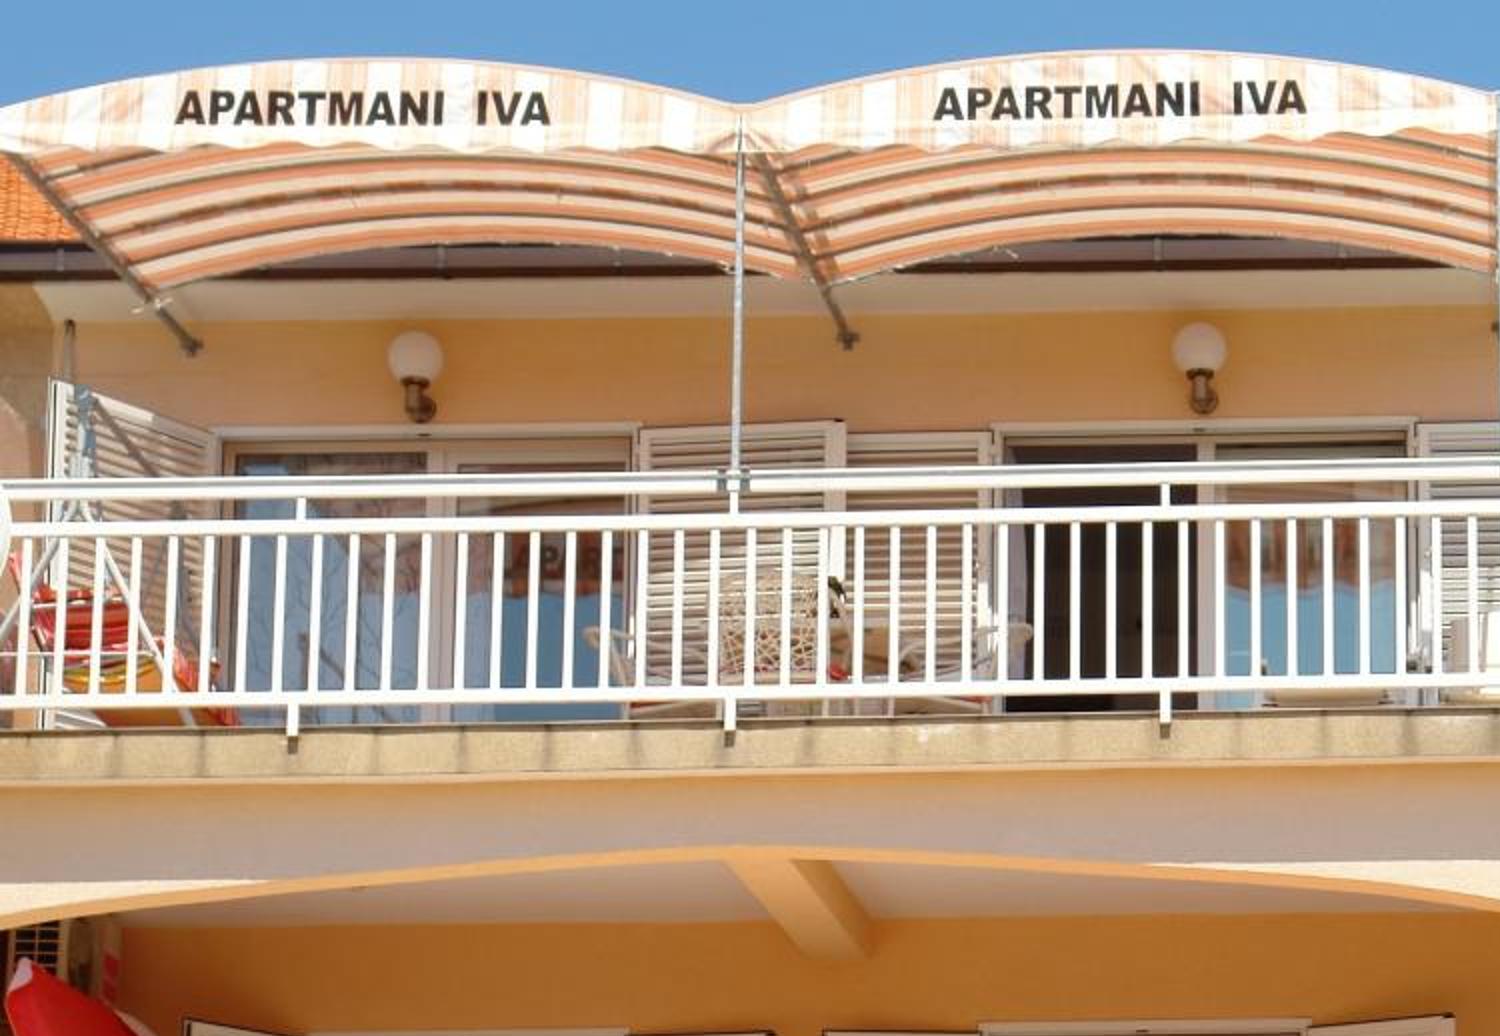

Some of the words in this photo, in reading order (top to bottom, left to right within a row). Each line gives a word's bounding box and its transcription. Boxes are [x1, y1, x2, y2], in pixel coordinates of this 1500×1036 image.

[176, 91, 445, 126] APARTMANI
[477, 91, 550, 126] IVA
[933, 82, 1200, 120] APARTMANI
[1233, 80, 1307, 115] IVA
